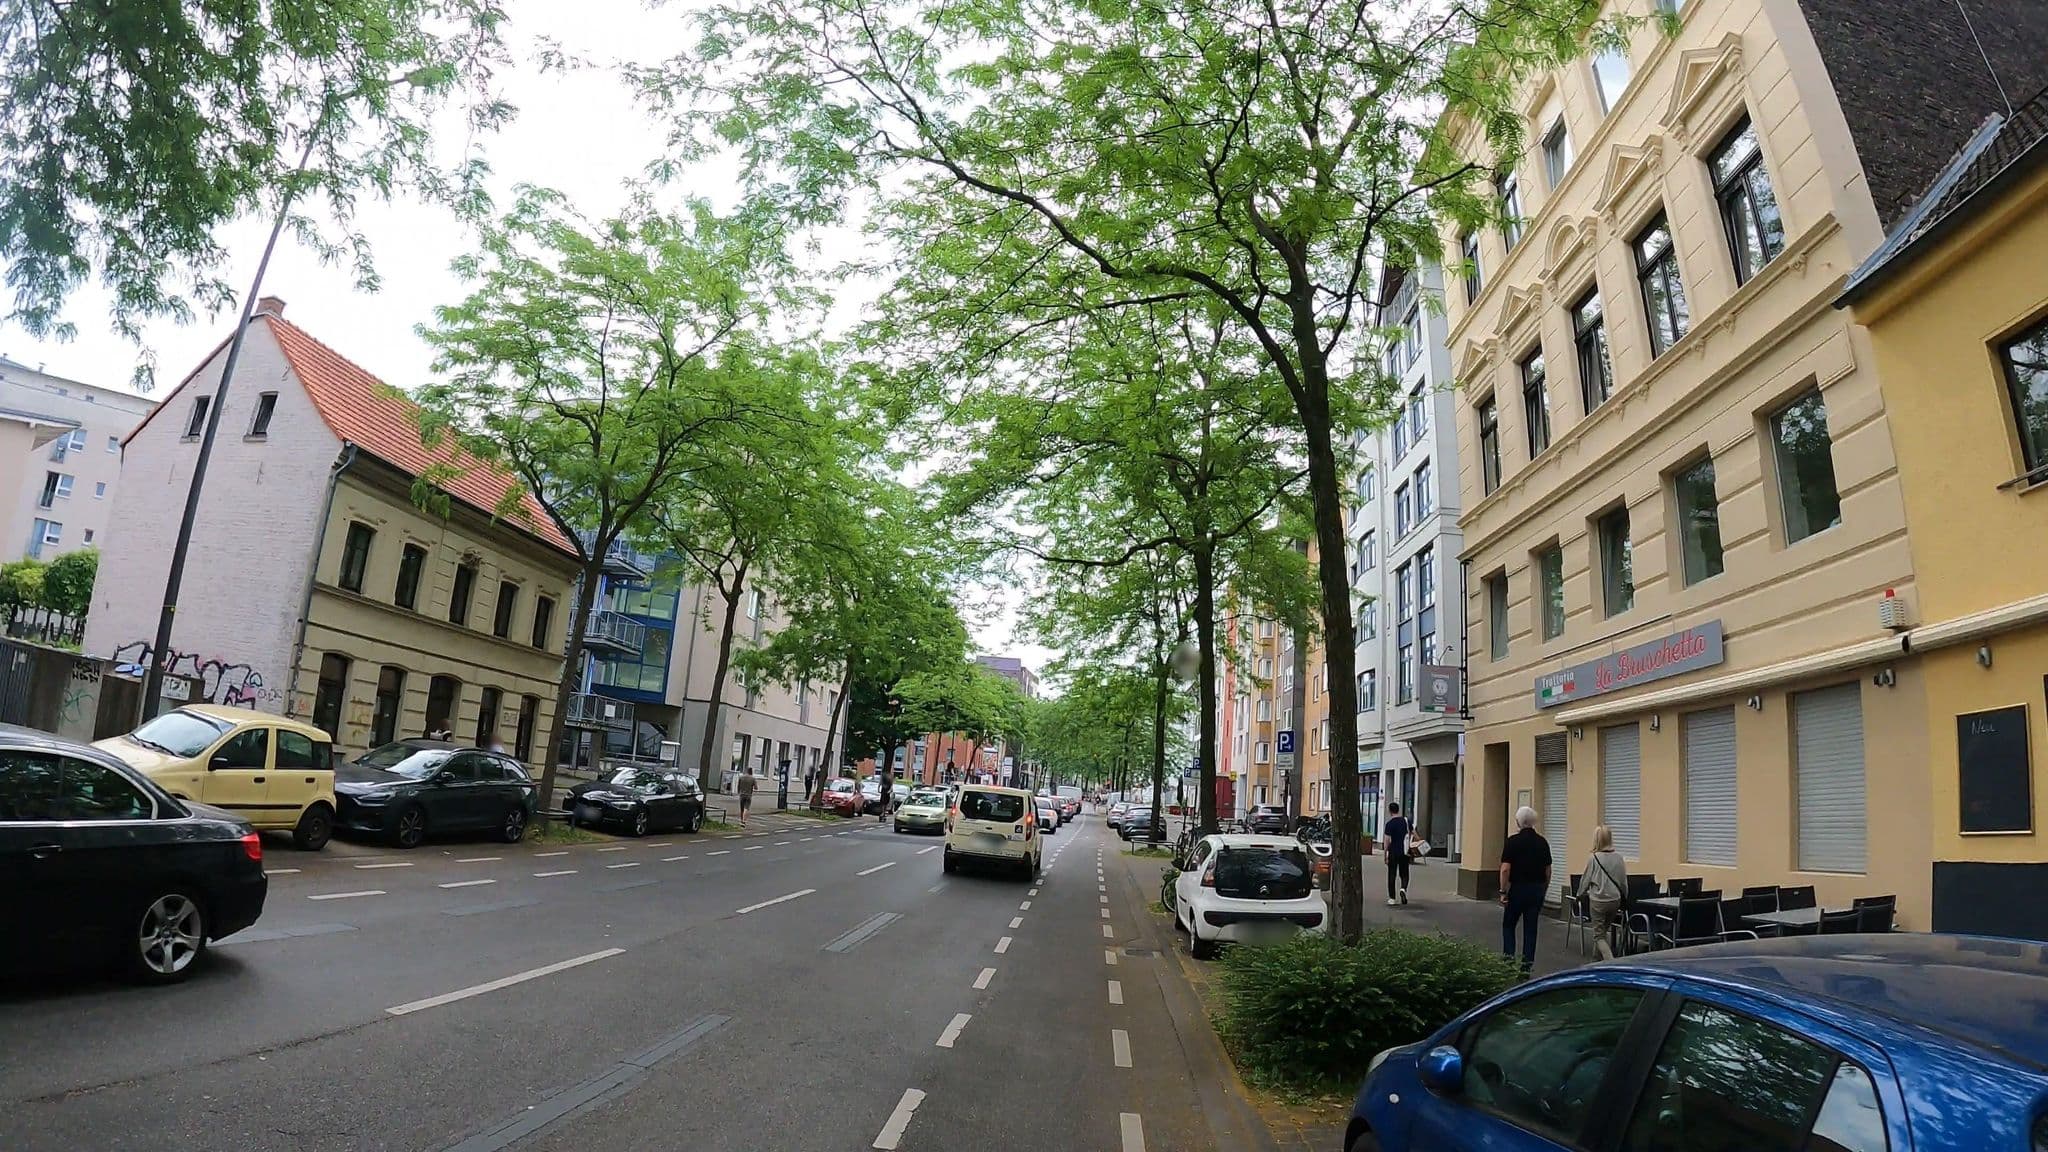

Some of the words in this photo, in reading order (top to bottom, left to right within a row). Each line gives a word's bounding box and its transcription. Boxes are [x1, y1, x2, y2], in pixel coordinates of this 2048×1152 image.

[1595, 662, 1612, 689] La
[1616, 630, 1705, 681] Bruschetta
[1280, 733, 1290, 750] P
